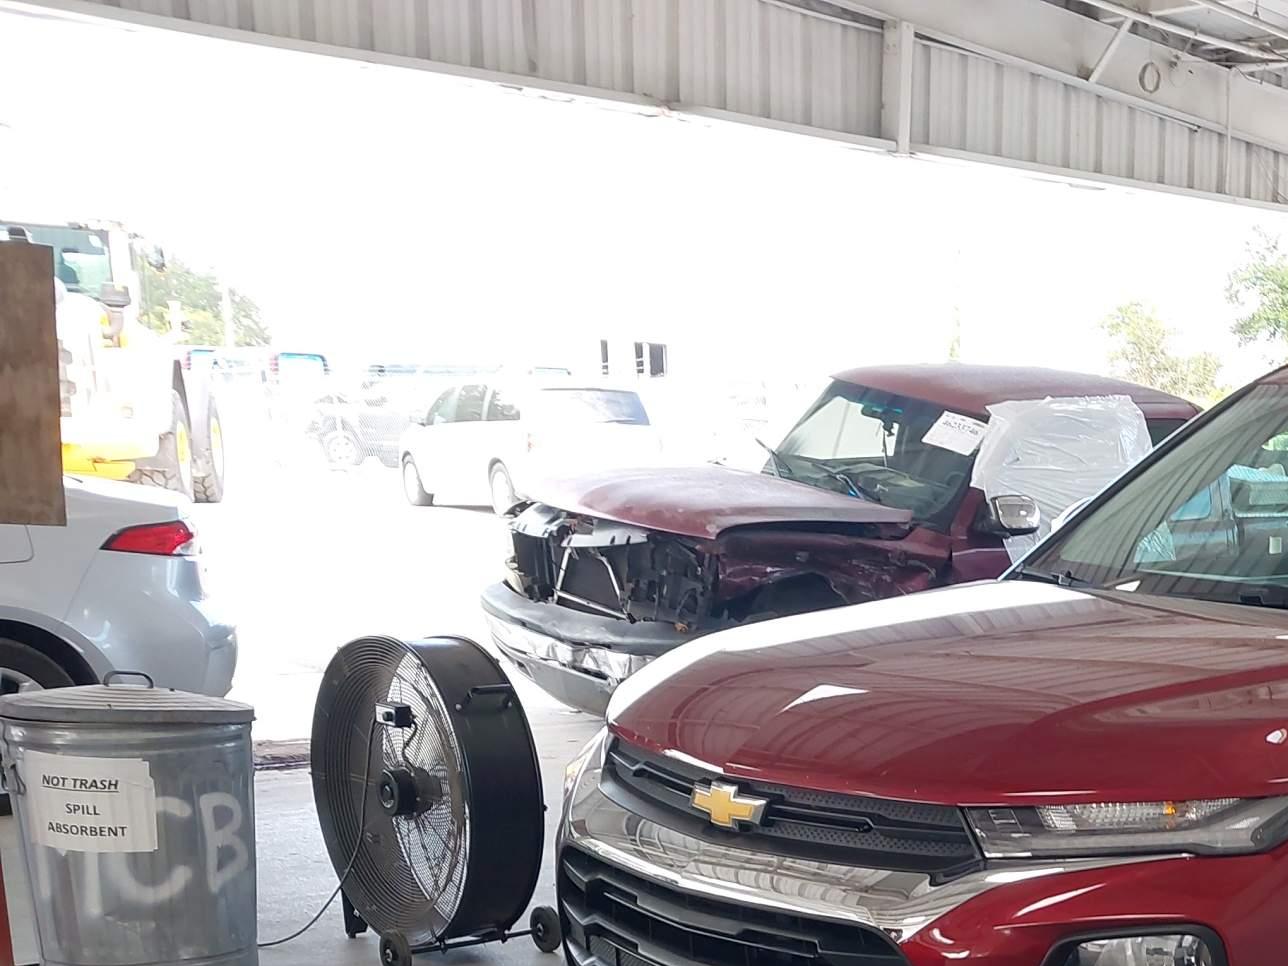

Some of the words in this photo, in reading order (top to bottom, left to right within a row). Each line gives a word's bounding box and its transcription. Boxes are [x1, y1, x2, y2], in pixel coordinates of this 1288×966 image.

[42, 774, 68, 787] NOT
[72, 778, 119, 790] TRASH
[65, 803, 100, 816] SPILL
[48, 821, 127, 837] ABSORBENT
